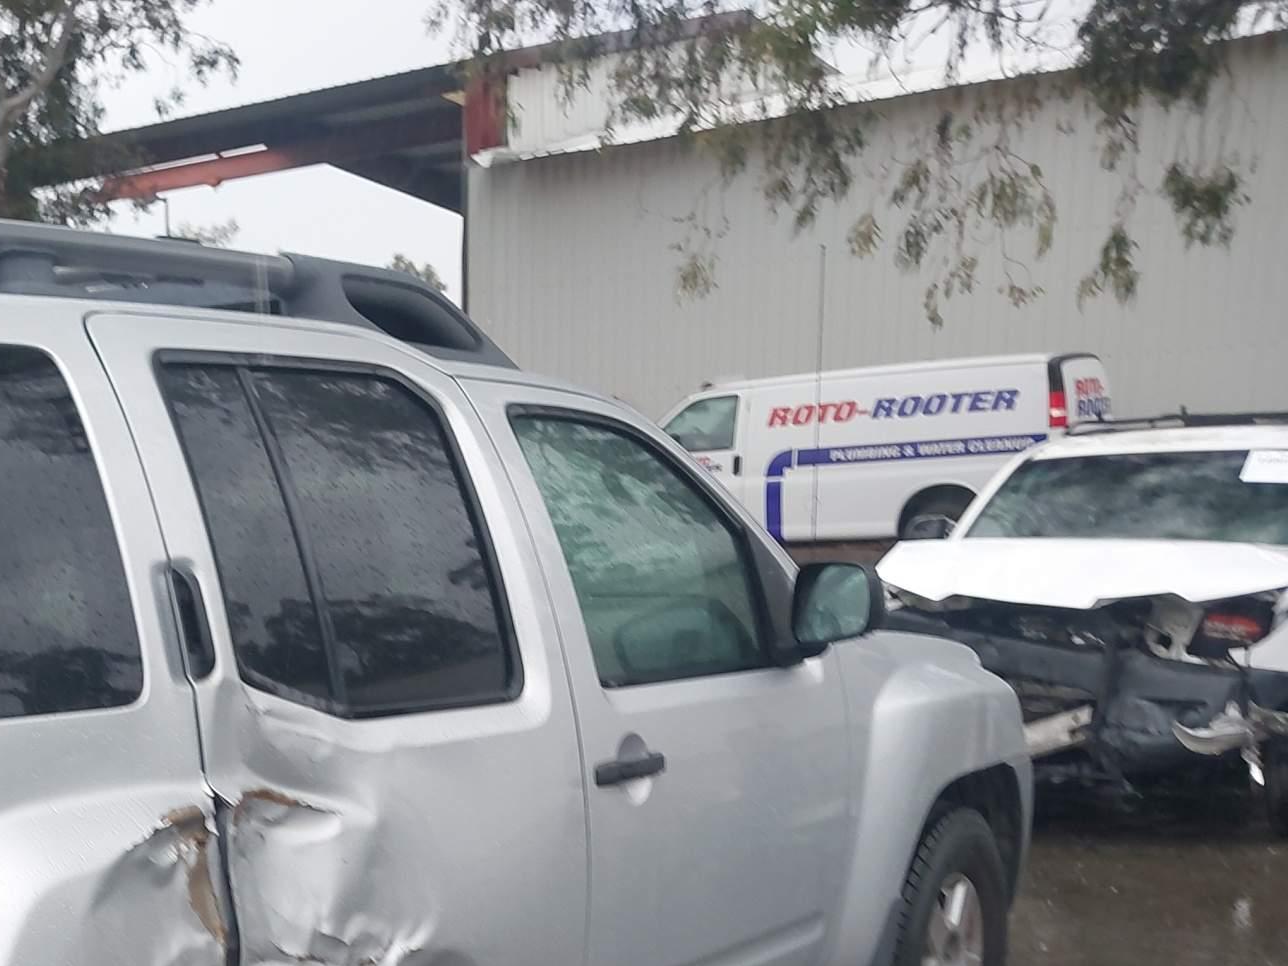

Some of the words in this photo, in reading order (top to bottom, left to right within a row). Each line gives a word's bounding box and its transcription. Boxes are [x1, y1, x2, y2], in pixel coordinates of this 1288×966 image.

[767, 388, 1020, 428] ROTO-ROOTER
[829, 444, 902, 462] PLUMBING
[918, 440, 966, 457] WATER
